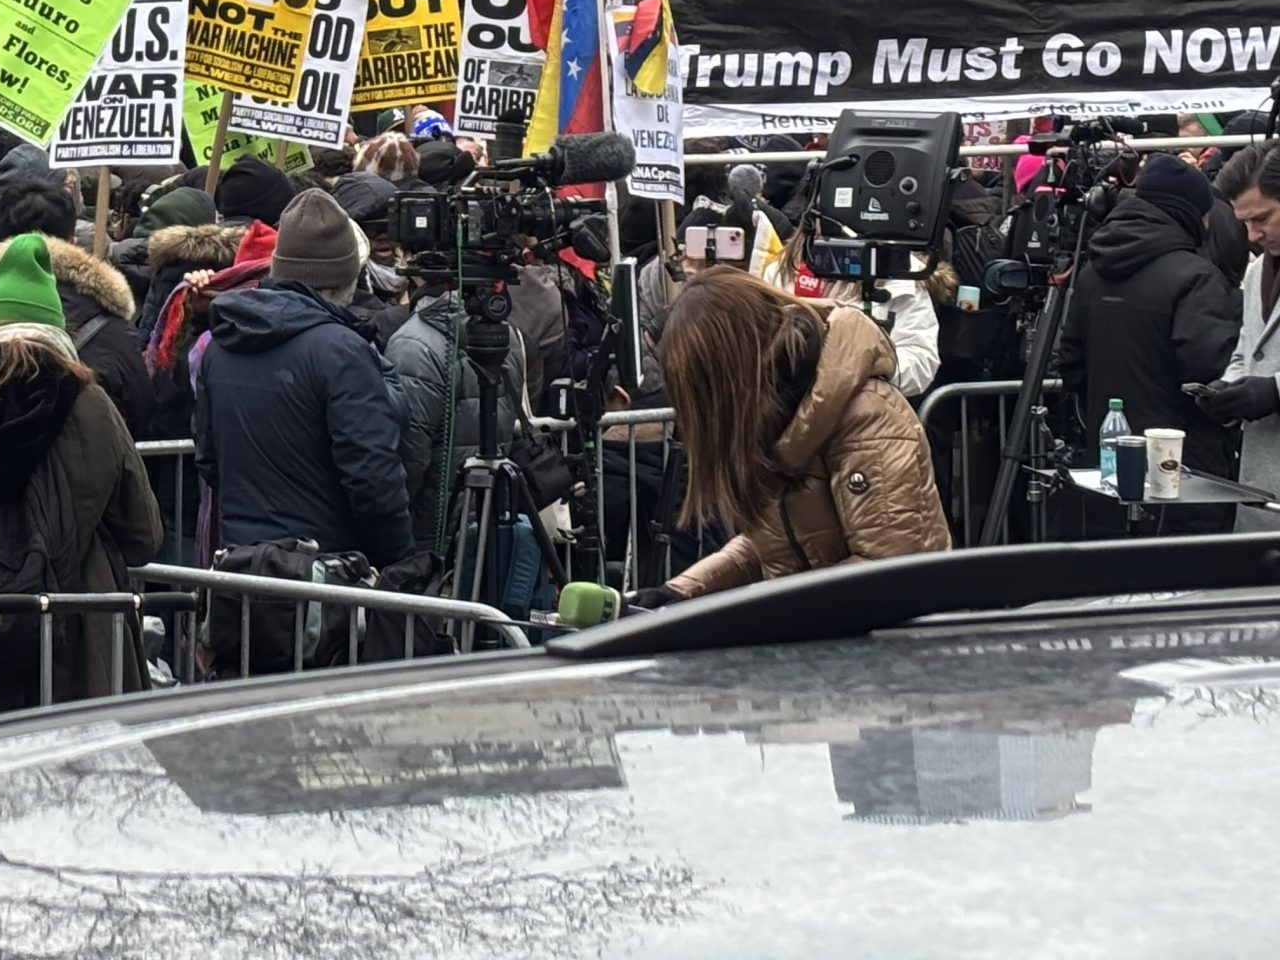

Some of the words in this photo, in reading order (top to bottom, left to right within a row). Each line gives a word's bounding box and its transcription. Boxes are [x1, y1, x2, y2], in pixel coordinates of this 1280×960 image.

[15, 20, 36, 36] and
[111, 6, 179, 63] U.S.
[271, 27, 303, 41] THE
[422, 22, 457, 49] THE
[467, 23, 540, 53] OU
[186, 18, 220, 50] WAR
[221, 23, 301, 70] MACHINE
[3, 33, 73, 91] Flores,
[243, 63, 252, 74] &
[464, 58, 487, 83] OF
[677, 43, 852, 96] Trump
[872, 36, 1024, 84] Must
[1042, 32, 1122, 77] Go
[75, 73, 178, 103] WAR
[187, 63, 289, 96] SLWEB.ORG
[297, 68, 342, 117] OIL
[103, 96, 123, 105] ON
[461, 85, 536, 122] CARIBB
[656, 104, 669, 124] DE
[59, 103, 175, 141] VENEZUELA
[231, 116, 338, 142] PSLWEB.ORG
[295, 114, 303, 126] &
[122, 144, 131, 157] &
